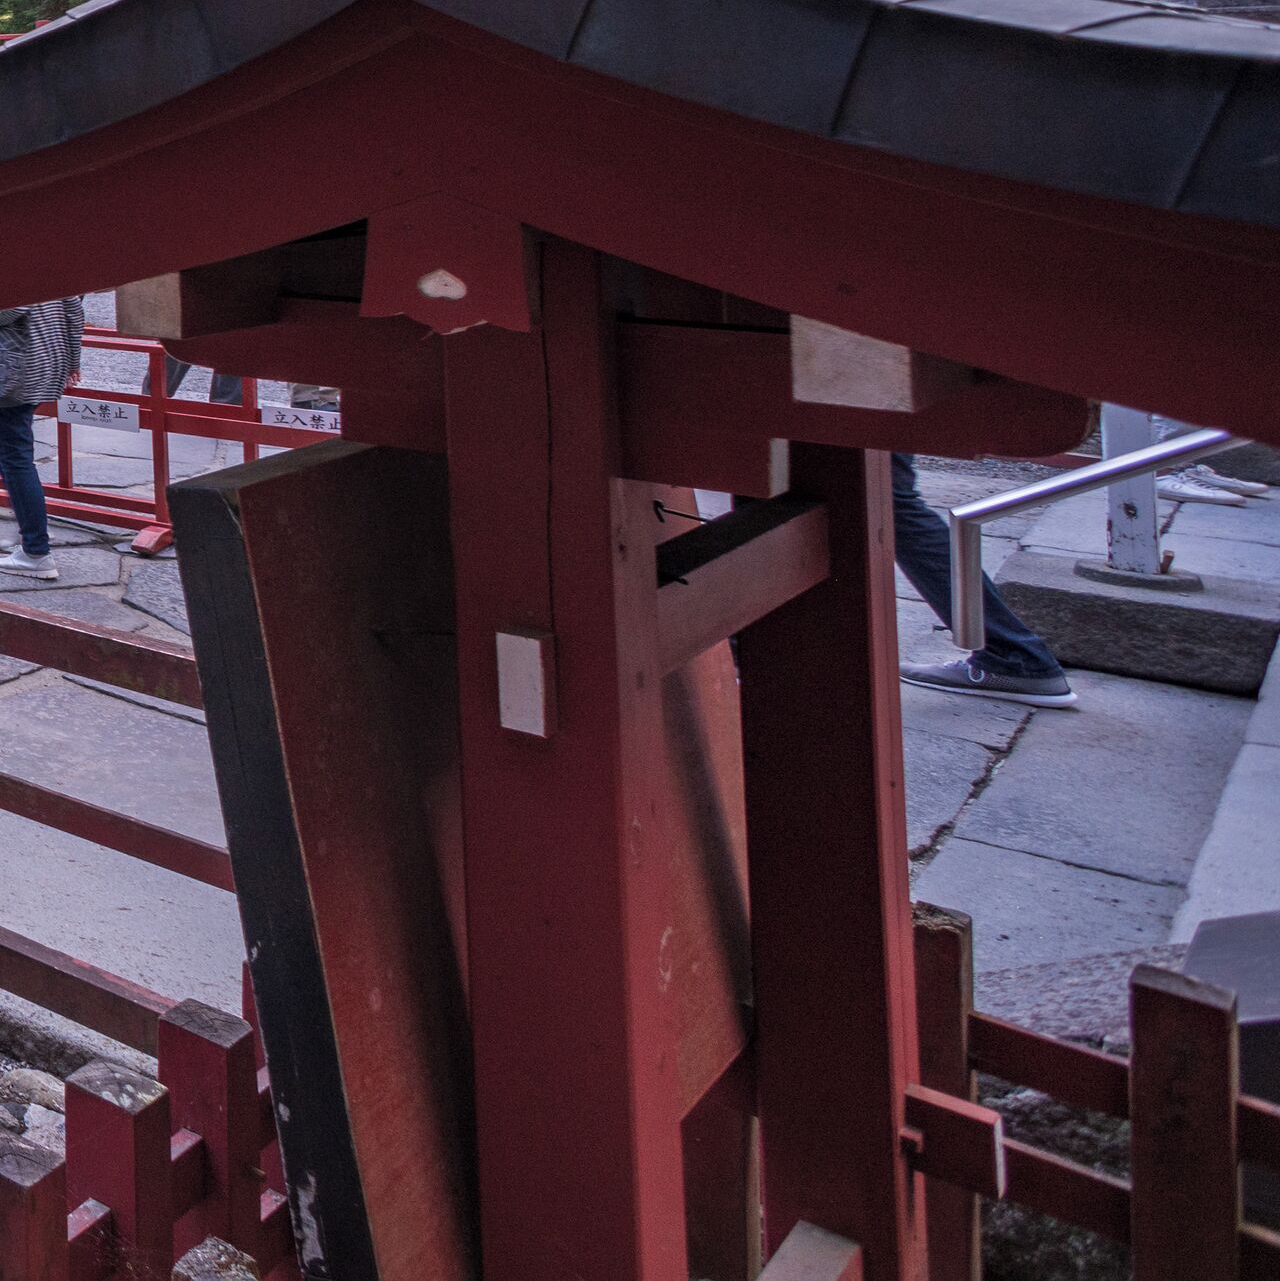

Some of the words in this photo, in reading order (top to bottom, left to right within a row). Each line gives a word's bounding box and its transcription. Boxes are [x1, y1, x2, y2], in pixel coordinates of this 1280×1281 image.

[66, 401, 128, 419] 立入禁止
[273, 411, 341, 430] 立入禁止
